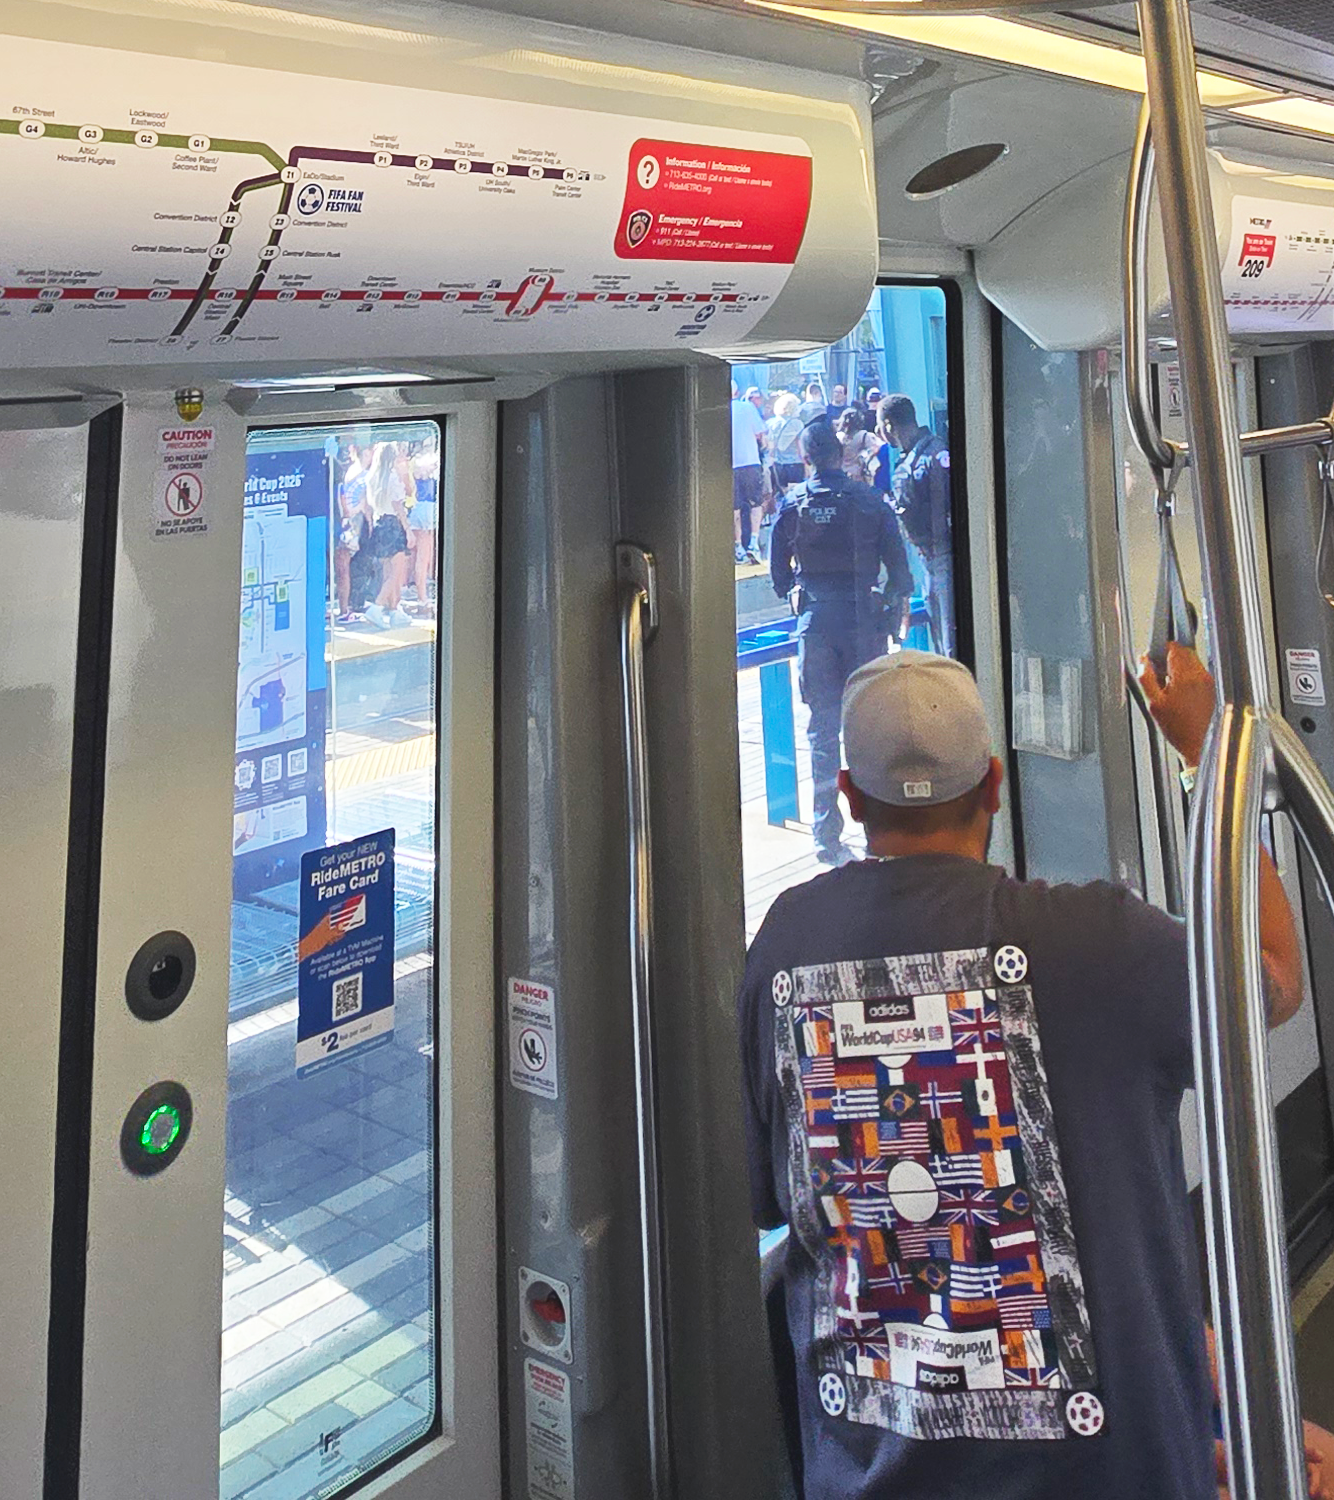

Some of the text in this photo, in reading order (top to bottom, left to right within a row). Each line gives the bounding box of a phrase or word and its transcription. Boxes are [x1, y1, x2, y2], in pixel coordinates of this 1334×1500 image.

[12, 106, 55, 117] 67th Street
[25, 124, 39, 133] G4
[84, 130, 97, 139] G3
[140, 135, 152, 144] G2
[193, 140, 205, 148] G1
[57, 154, 116, 166] Howard Hughes
[378, 155, 387, 163] P1
[419, 159, 428, 167] P2
[328, 189, 364, 201] FIFA FAN
[325, 202, 362, 213] FESTIVAL
[1241, 259, 1265, 278] 209
[150, 290, 168, 298] R17
[161, 429, 213, 442] CAUTION
[164, 455, 175, 463] DO
[190, 453, 209, 461] LEAN
[259, 477, 278, 491] Cup
[809, 506, 837, 516] POLICE
[320, 841, 378, 867] Get your NEW
[310, 851, 386, 887] RideMETRO
[318, 869, 379, 901] Fare Card
[513, 982, 550, 1002] DANGER
[869, 1003, 910, 1017] adidas
[321, 1032, 339, 1053] $2
